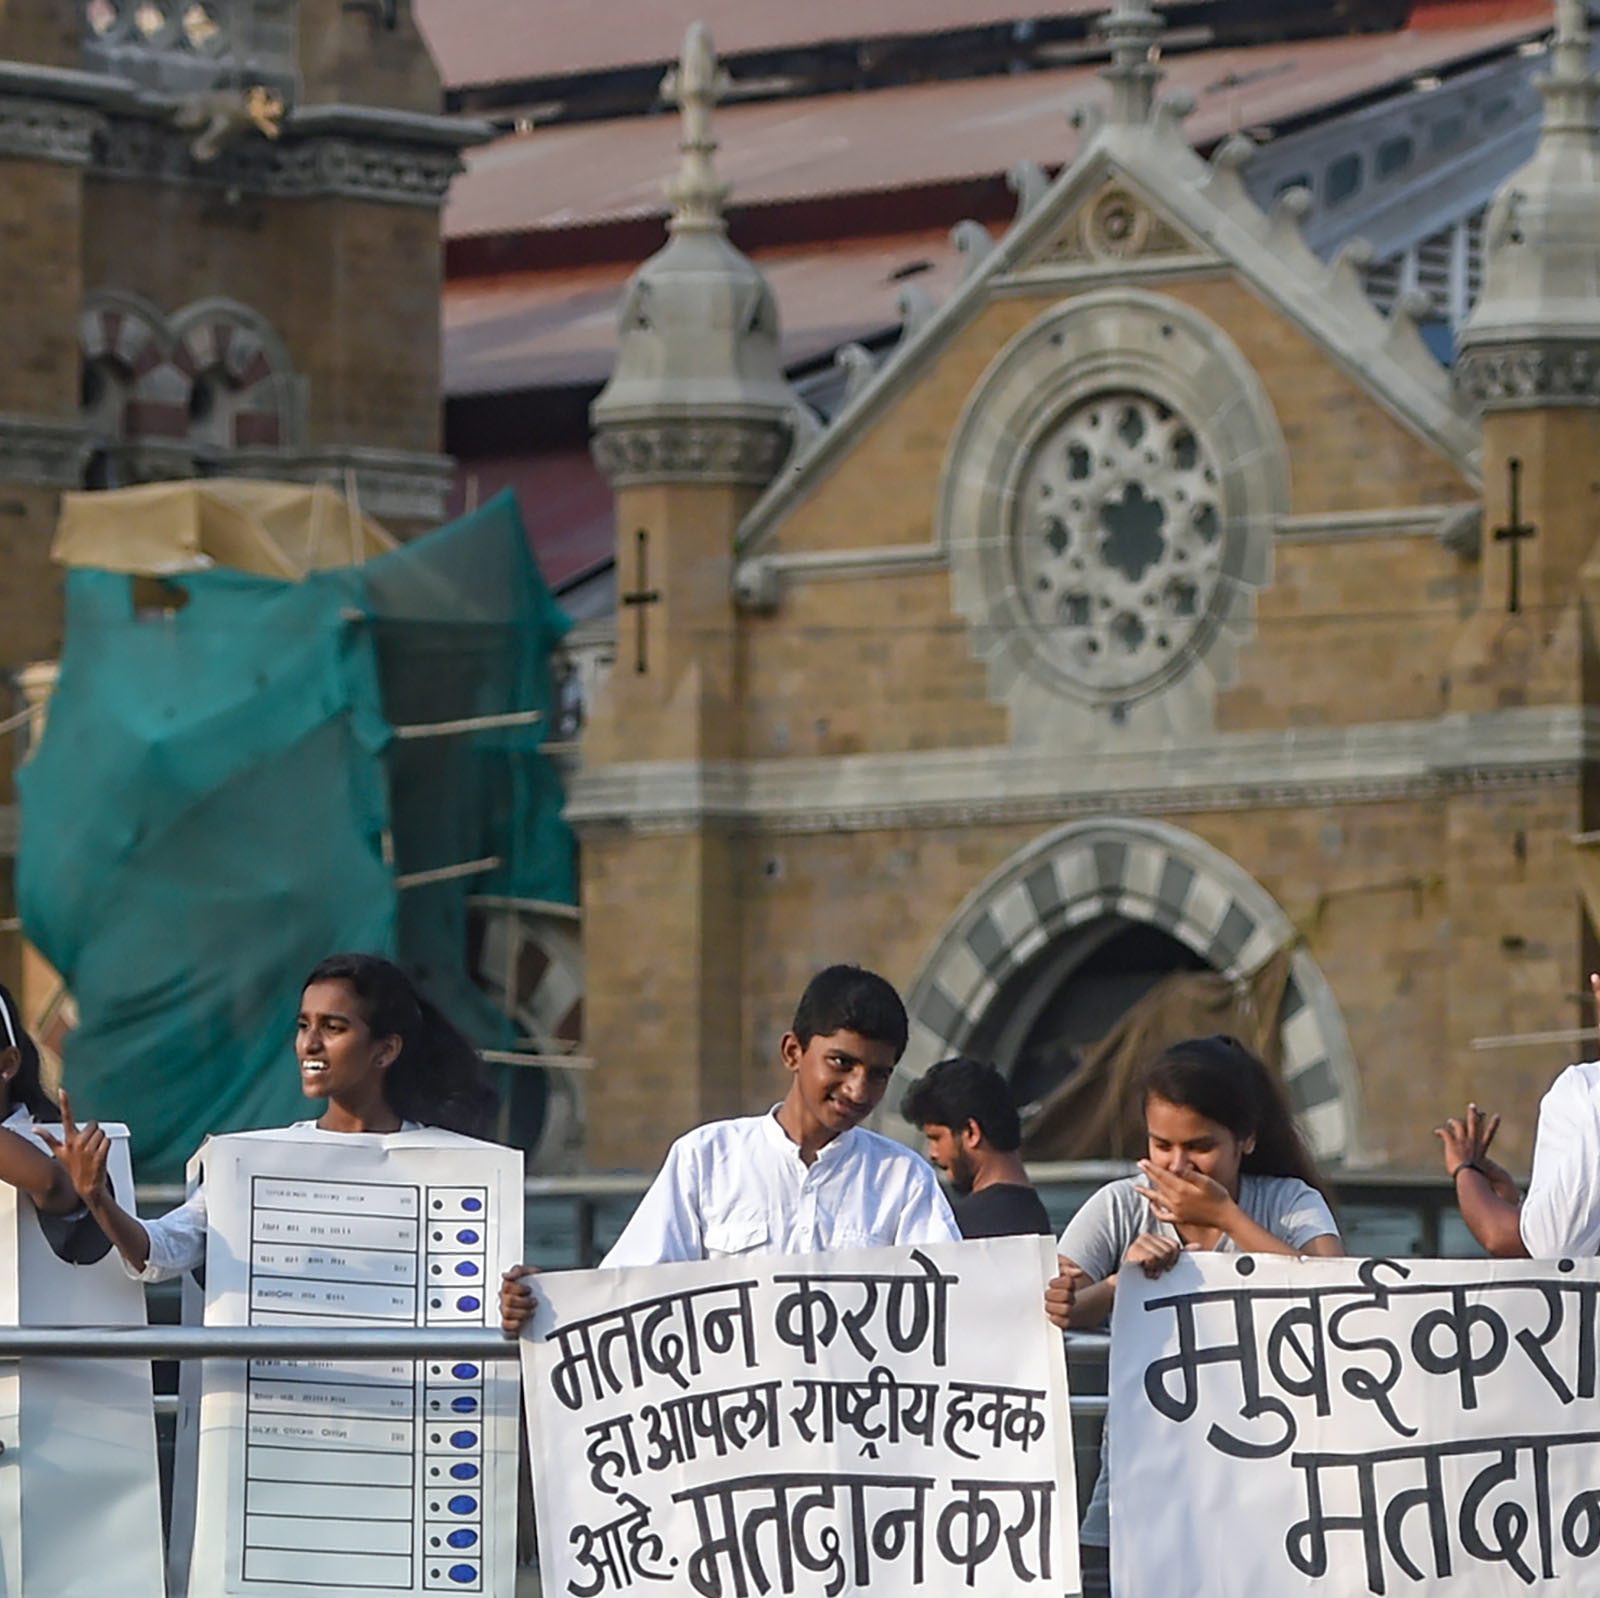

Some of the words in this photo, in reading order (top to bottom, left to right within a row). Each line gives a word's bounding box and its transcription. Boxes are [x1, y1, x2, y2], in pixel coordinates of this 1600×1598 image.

[544, 1280, 759, 1410] मतदान
[773, 1249, 959, 1367] करणे
[585, 1413, 642, 1495] हा
[640, 1380, 782, 1471] आपला
[788, 1365, 940, 1459] राष्ट्रीय
[936, 1479, 1056, 1587] करा
